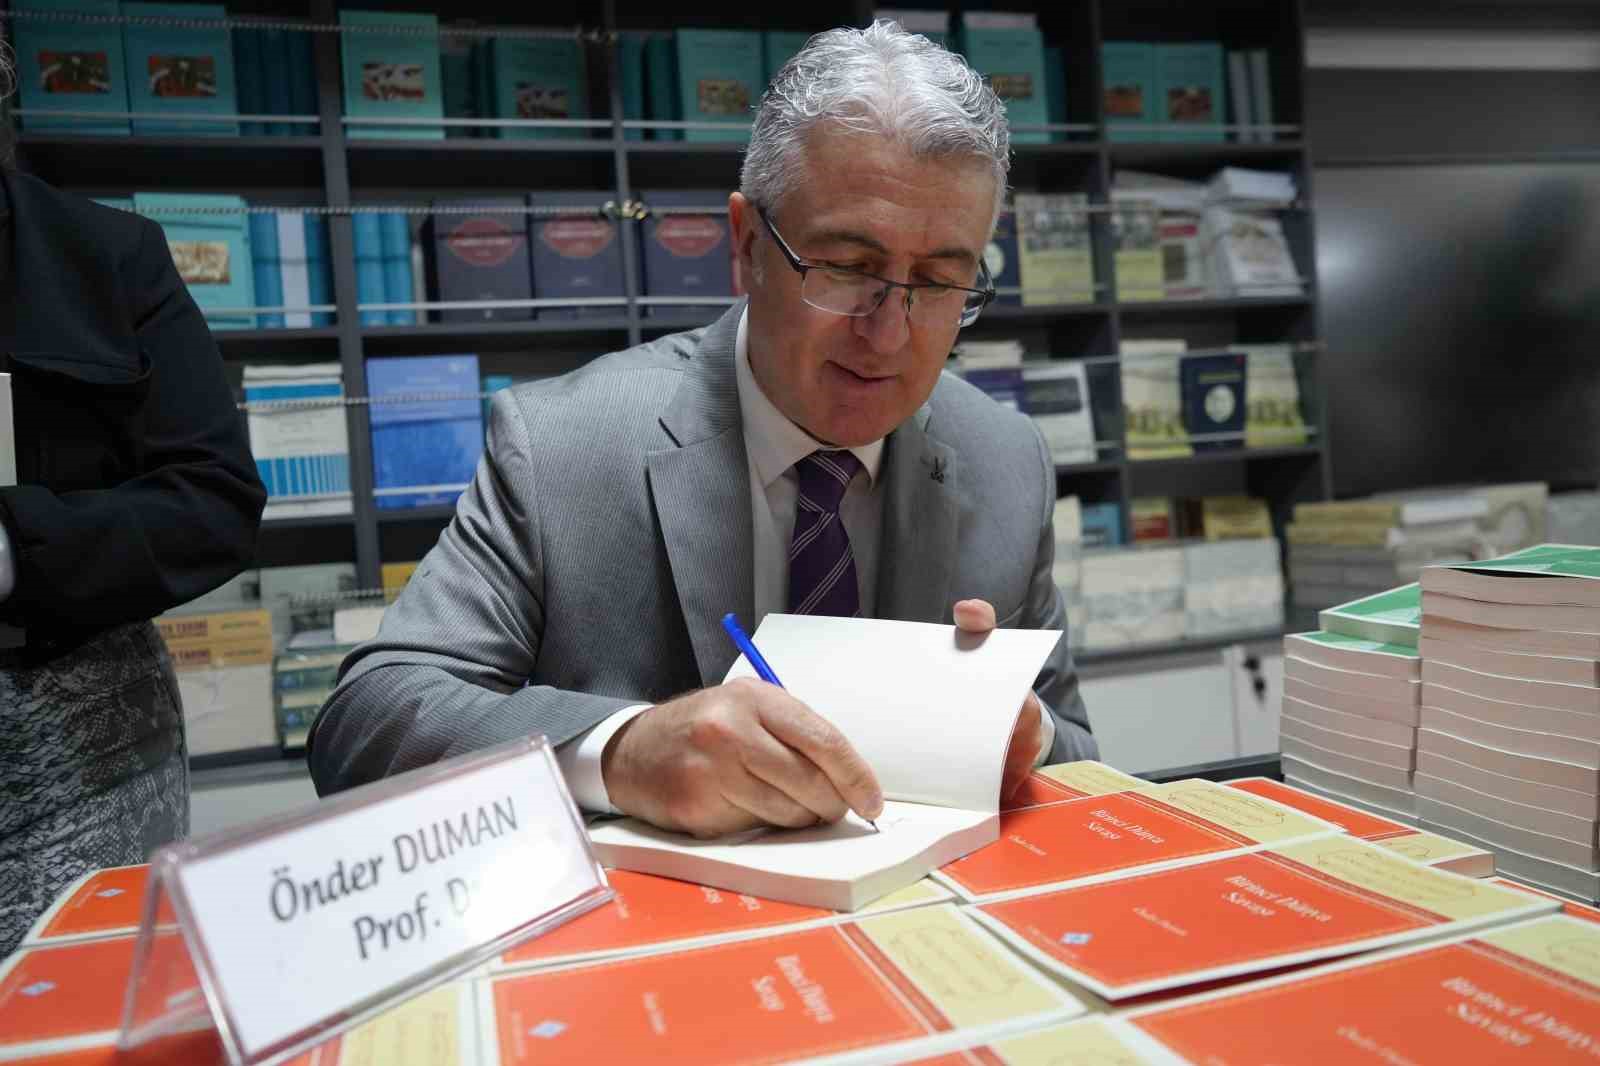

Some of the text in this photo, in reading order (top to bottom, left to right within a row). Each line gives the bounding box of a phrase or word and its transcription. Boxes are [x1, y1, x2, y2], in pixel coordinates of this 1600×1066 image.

[269, 796, 518, 922] Önder DUMAN
[353, 892, 441, 960] Prof.
